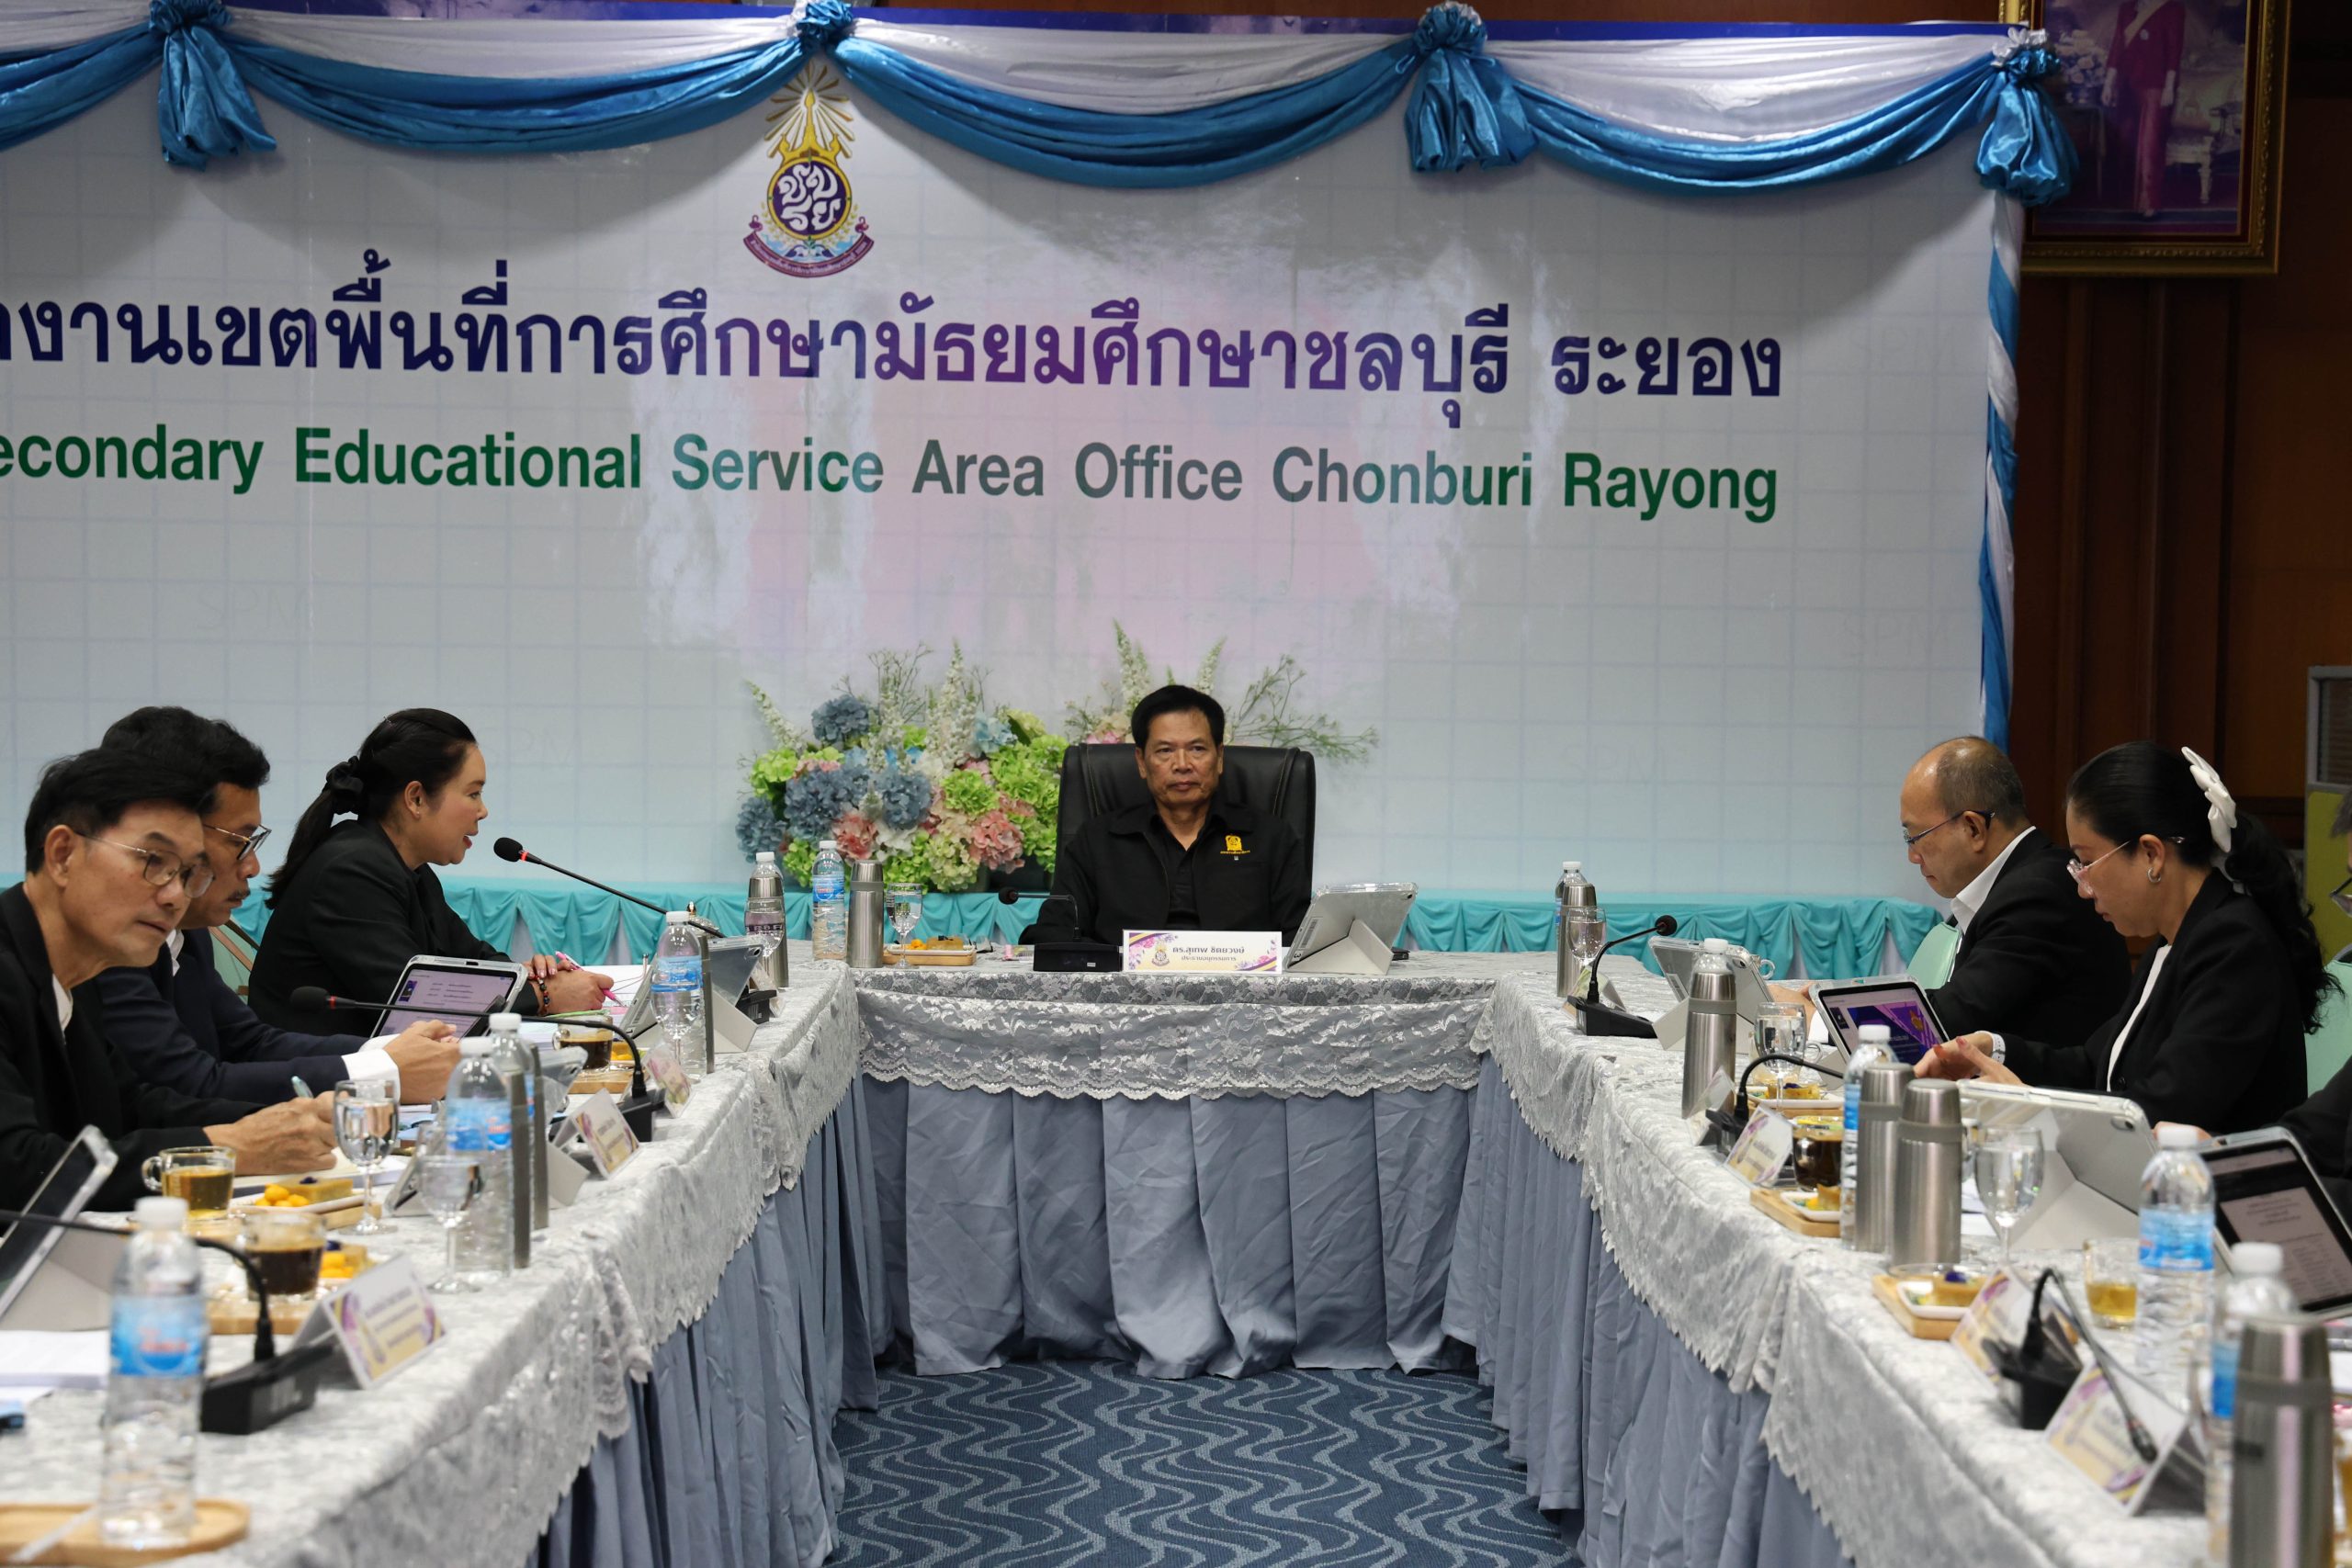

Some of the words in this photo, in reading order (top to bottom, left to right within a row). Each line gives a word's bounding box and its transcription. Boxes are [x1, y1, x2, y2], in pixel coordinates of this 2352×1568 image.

[1551, 334, 1781, 398] ระยอง
[295, 426, 641, 490] Educational
[672, 434, 885, 493] Service
[911, 439, 1044, 497] Area
[1075, 442, 1243, 502] Office
[1272, 446, 1532, 507] Chonburi
[1564, 452, 1777, 525] Rayong
